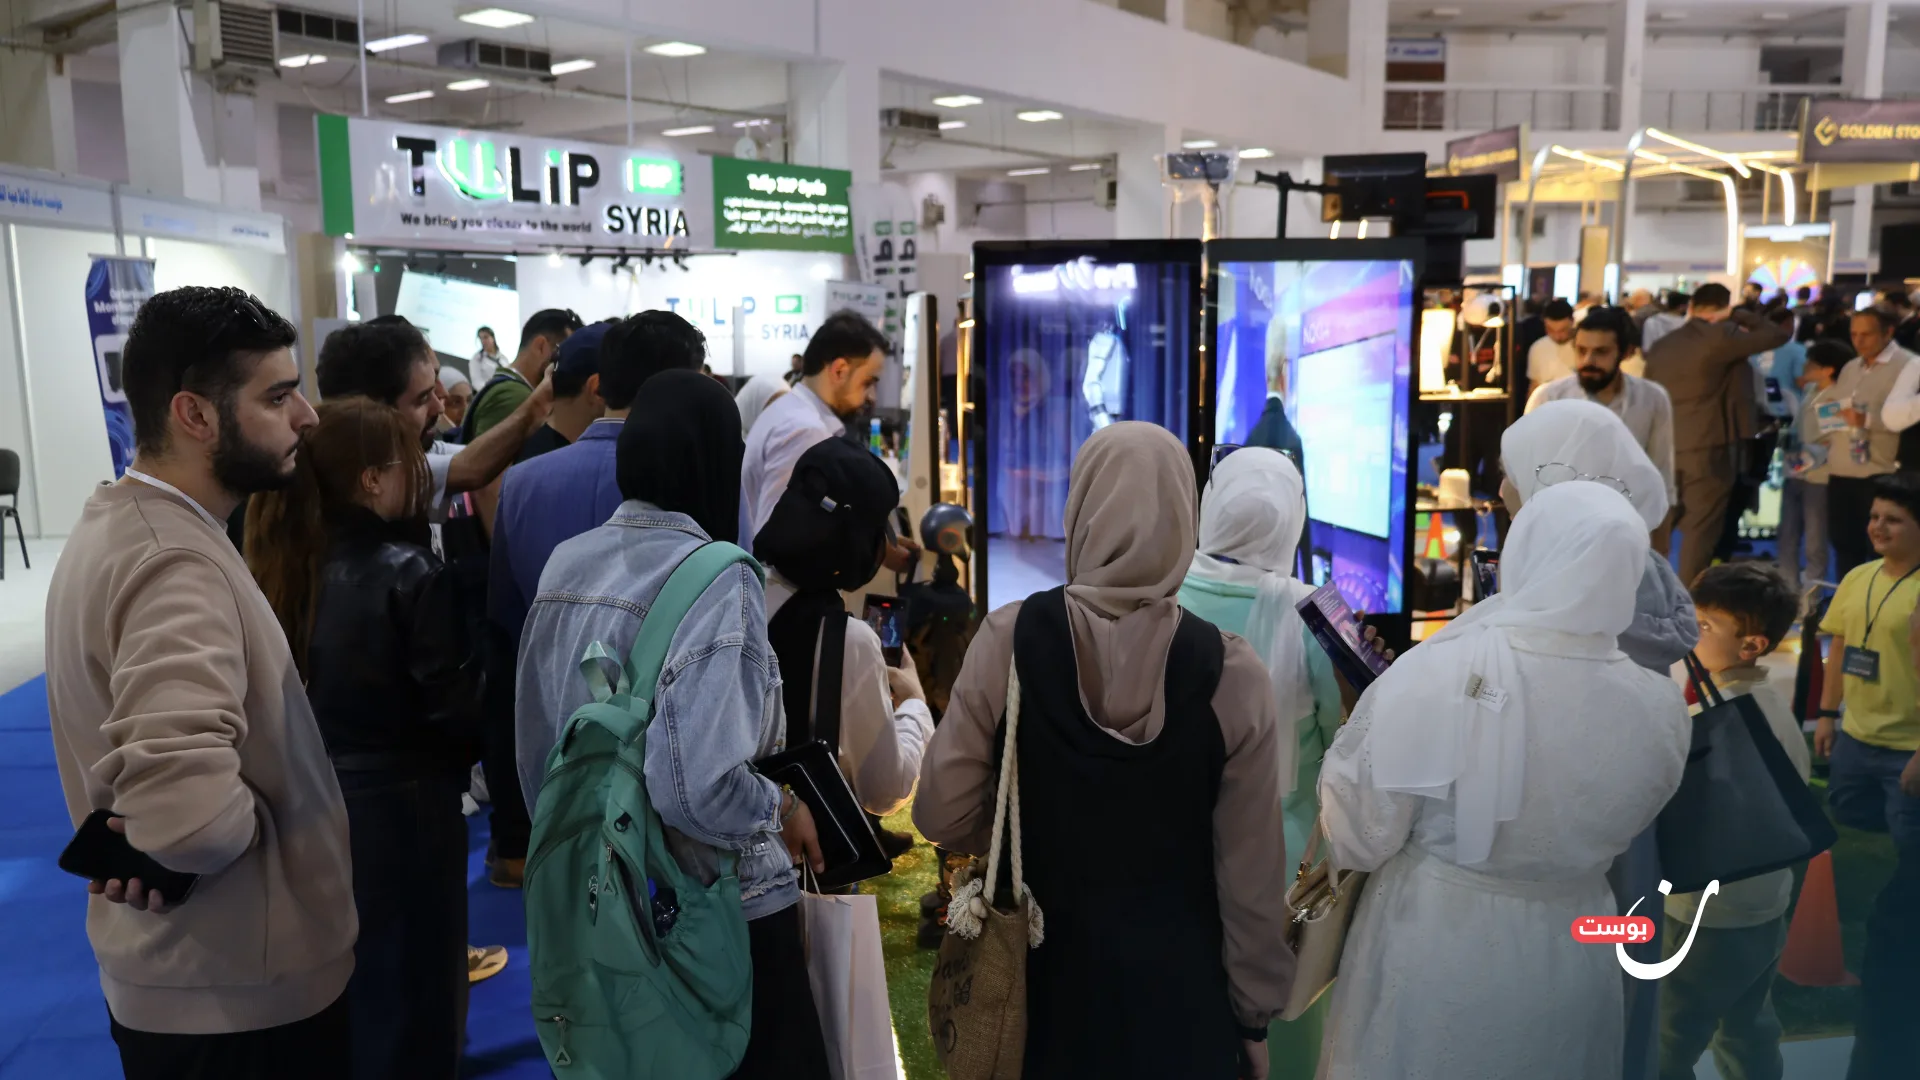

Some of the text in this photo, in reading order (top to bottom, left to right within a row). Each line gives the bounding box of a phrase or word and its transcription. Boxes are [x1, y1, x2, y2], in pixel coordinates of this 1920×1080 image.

[1839, 123, 1894, 139] GOLDEN
[401, 213, 420, 225] We
[425, 214, 457, 229] bring
[461, 217, 483, 230] you
[541, 220, 559, 231] the
[562, 221, 592, 232] world
[604, 205, 690, 237] SYRIA
[665, 296, 757, 326] TULP
[761, 323, 810, 341] SYRIA
